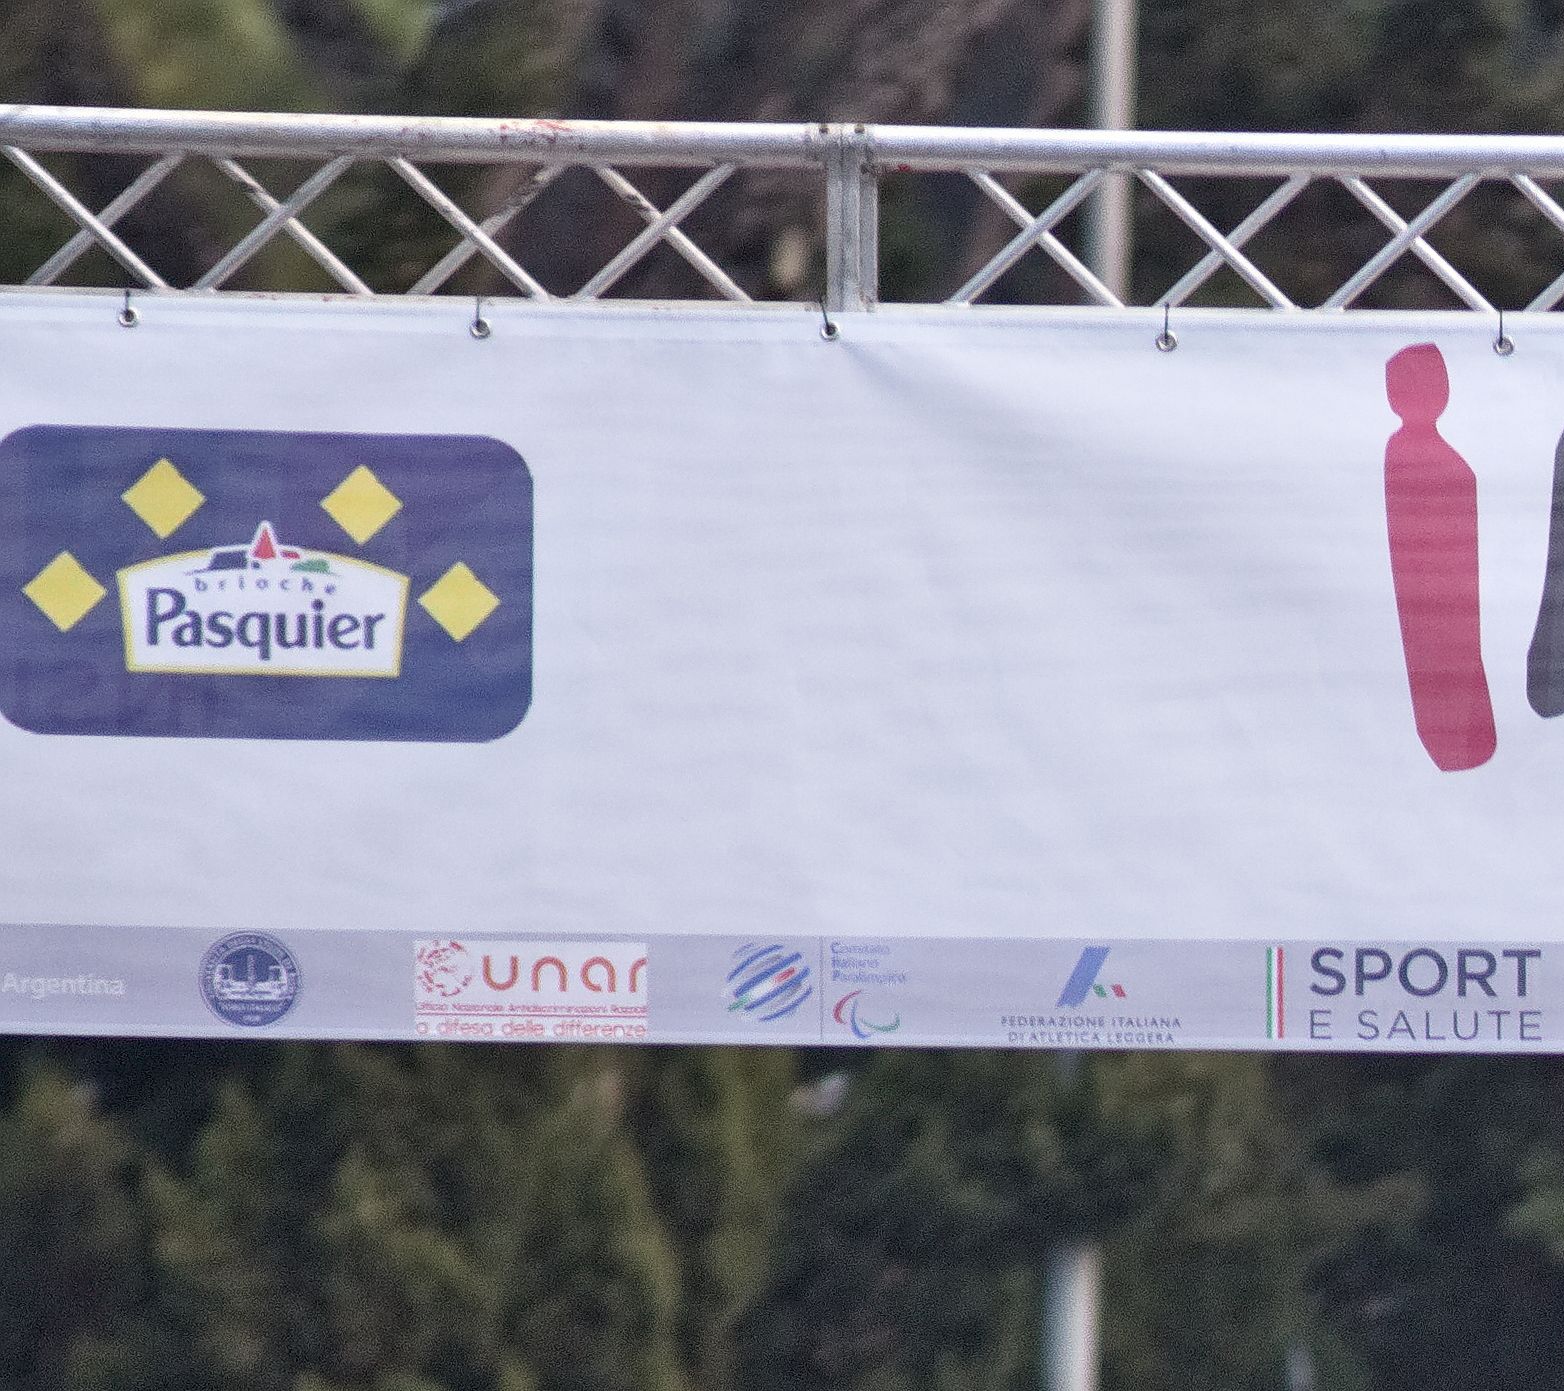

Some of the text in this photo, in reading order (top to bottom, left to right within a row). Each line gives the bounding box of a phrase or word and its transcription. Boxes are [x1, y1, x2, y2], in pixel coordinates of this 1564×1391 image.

[193, 576, 338, 596] brioche
[145, 586, 386, 661] Pasquier
[482, 955, 648, 993] unar
[1310, 947, 1542, 998] SPORT
[1001, 1015, 1183, 1029] FEDERAZIONE ITALIANA
[1030, 1031, 1100, 1044] ATLETICA
[1309, 1009, 1542, 1041] E SALUTE
